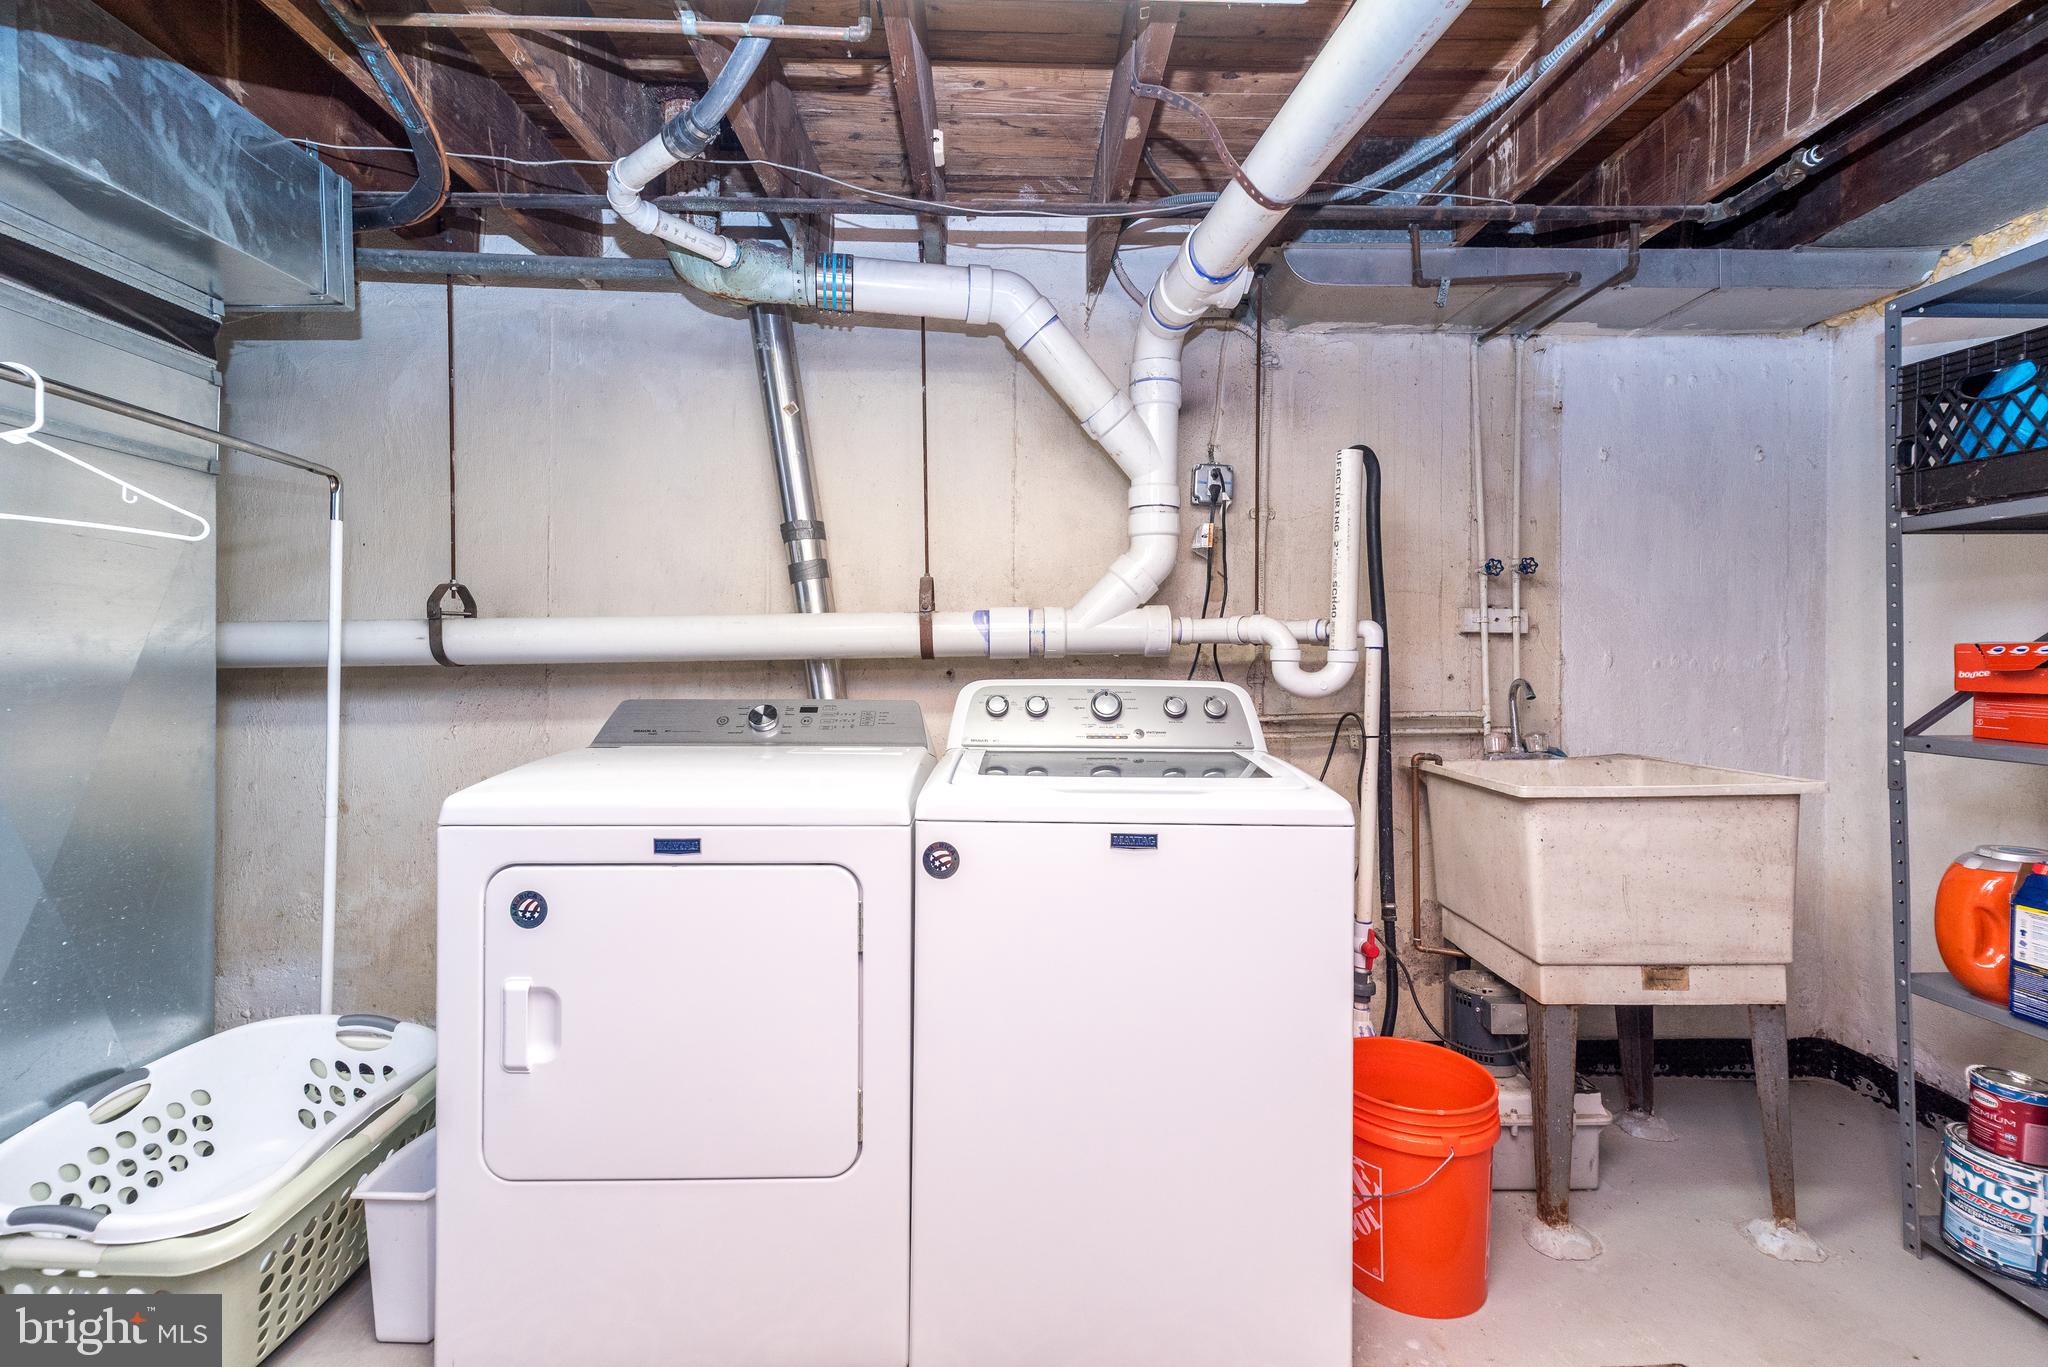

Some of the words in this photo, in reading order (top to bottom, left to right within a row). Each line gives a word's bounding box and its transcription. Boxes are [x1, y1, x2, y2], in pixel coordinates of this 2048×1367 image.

[1958, 670, 1991, 679] bounce
[1113, 835, 1156, 846] MAYTAG
[1948, 1182, 2034, 1224] EXTREME
